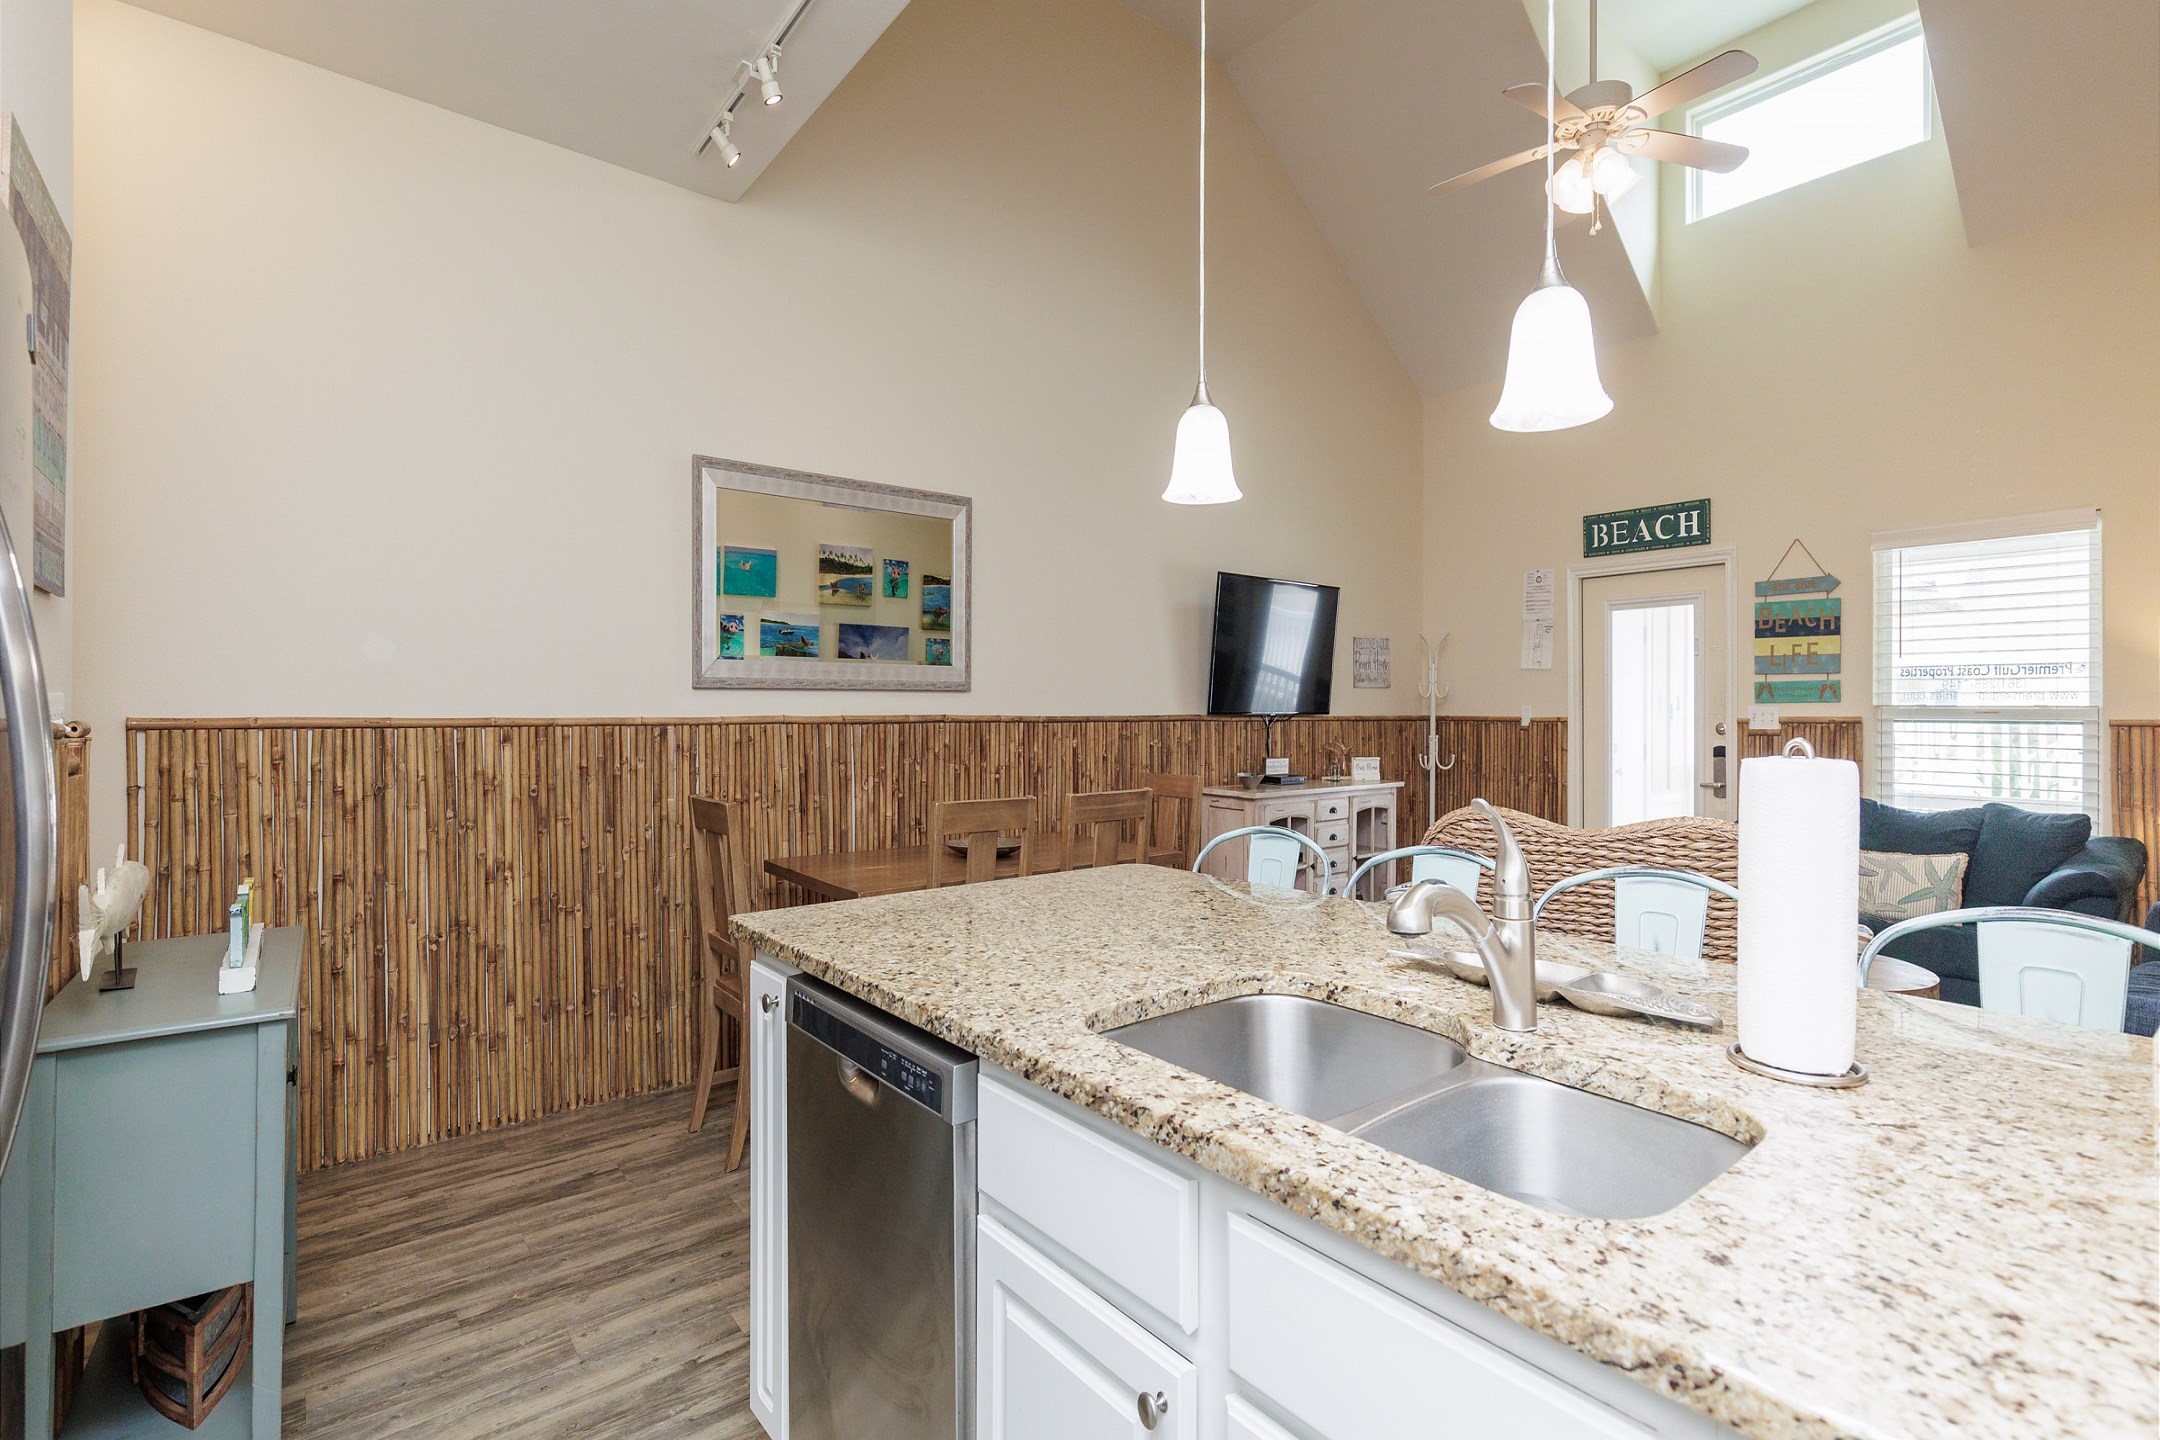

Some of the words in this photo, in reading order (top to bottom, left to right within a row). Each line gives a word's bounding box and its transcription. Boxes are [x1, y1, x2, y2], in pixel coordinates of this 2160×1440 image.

[1591, 509, 1701, 548] BEACH
[1758, 606, 1836, 633] BEACH
[1769, 641, 1820, 670] LIFE
